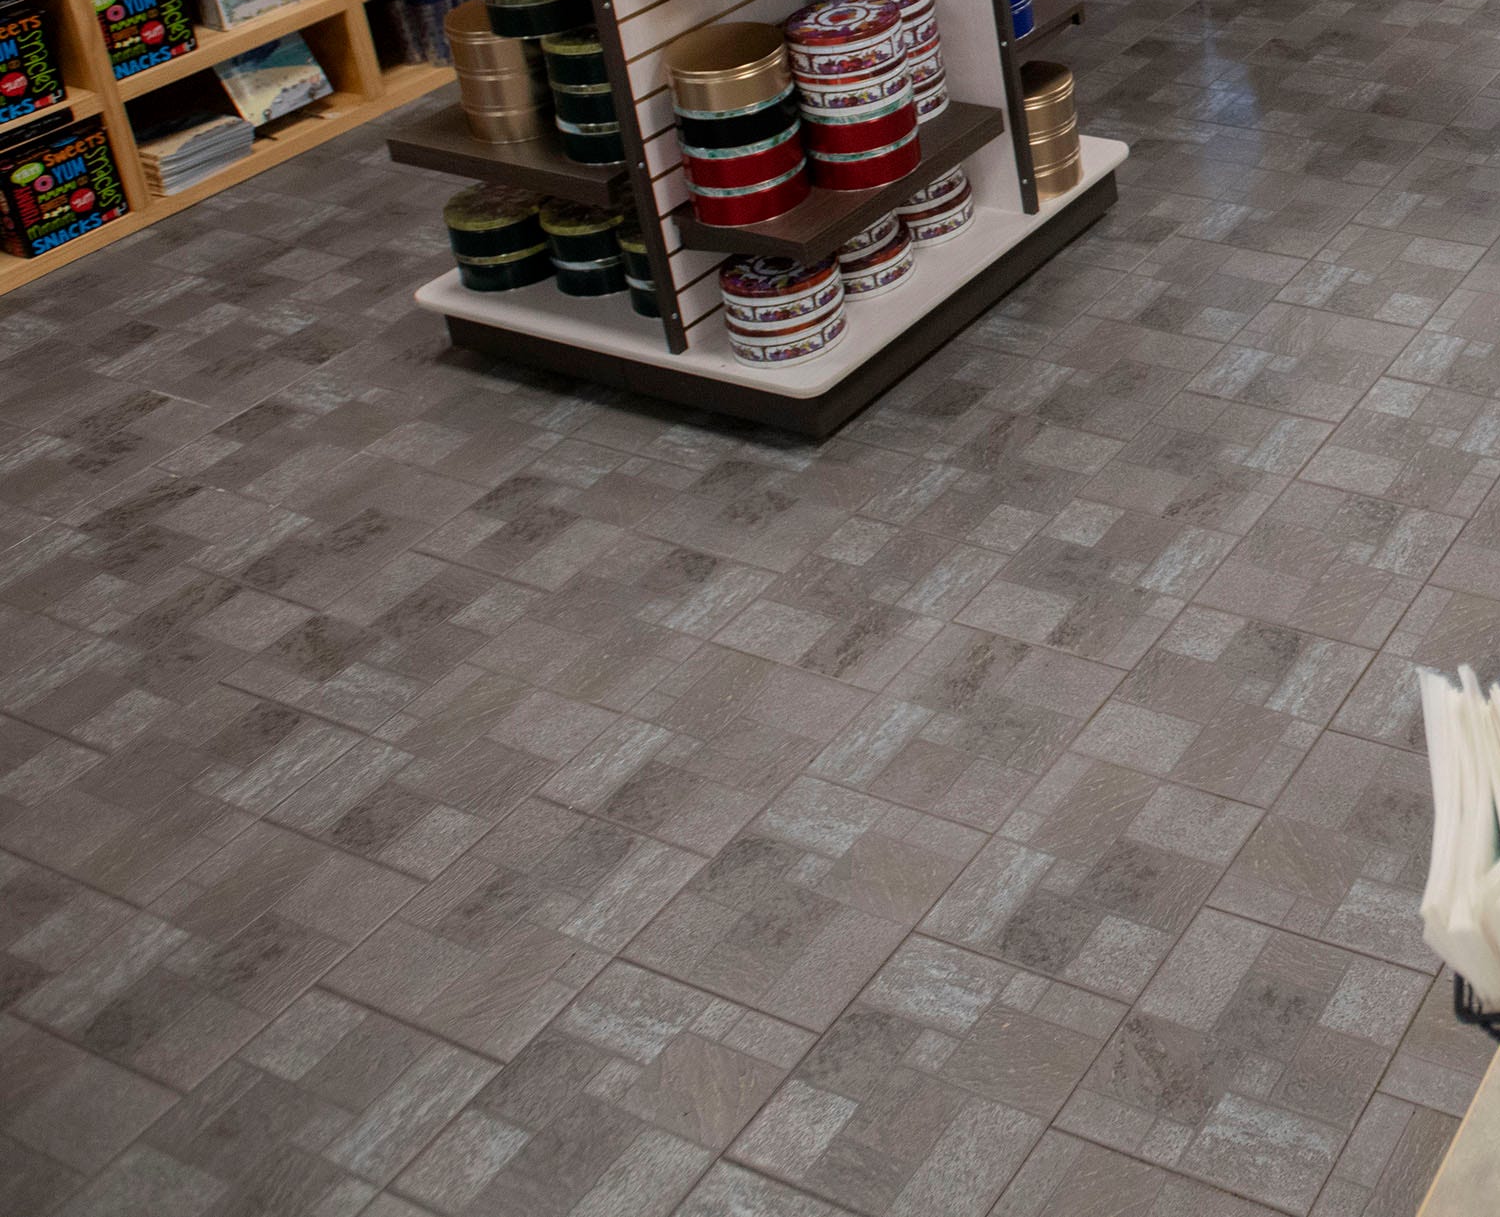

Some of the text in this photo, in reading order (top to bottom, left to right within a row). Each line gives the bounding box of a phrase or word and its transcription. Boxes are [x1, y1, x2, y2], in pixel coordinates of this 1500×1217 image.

[113, 46, 172, 79] NACKS
[51, 156, 87, 184] YUM
[32, 212, 103, 255] SNACKS
